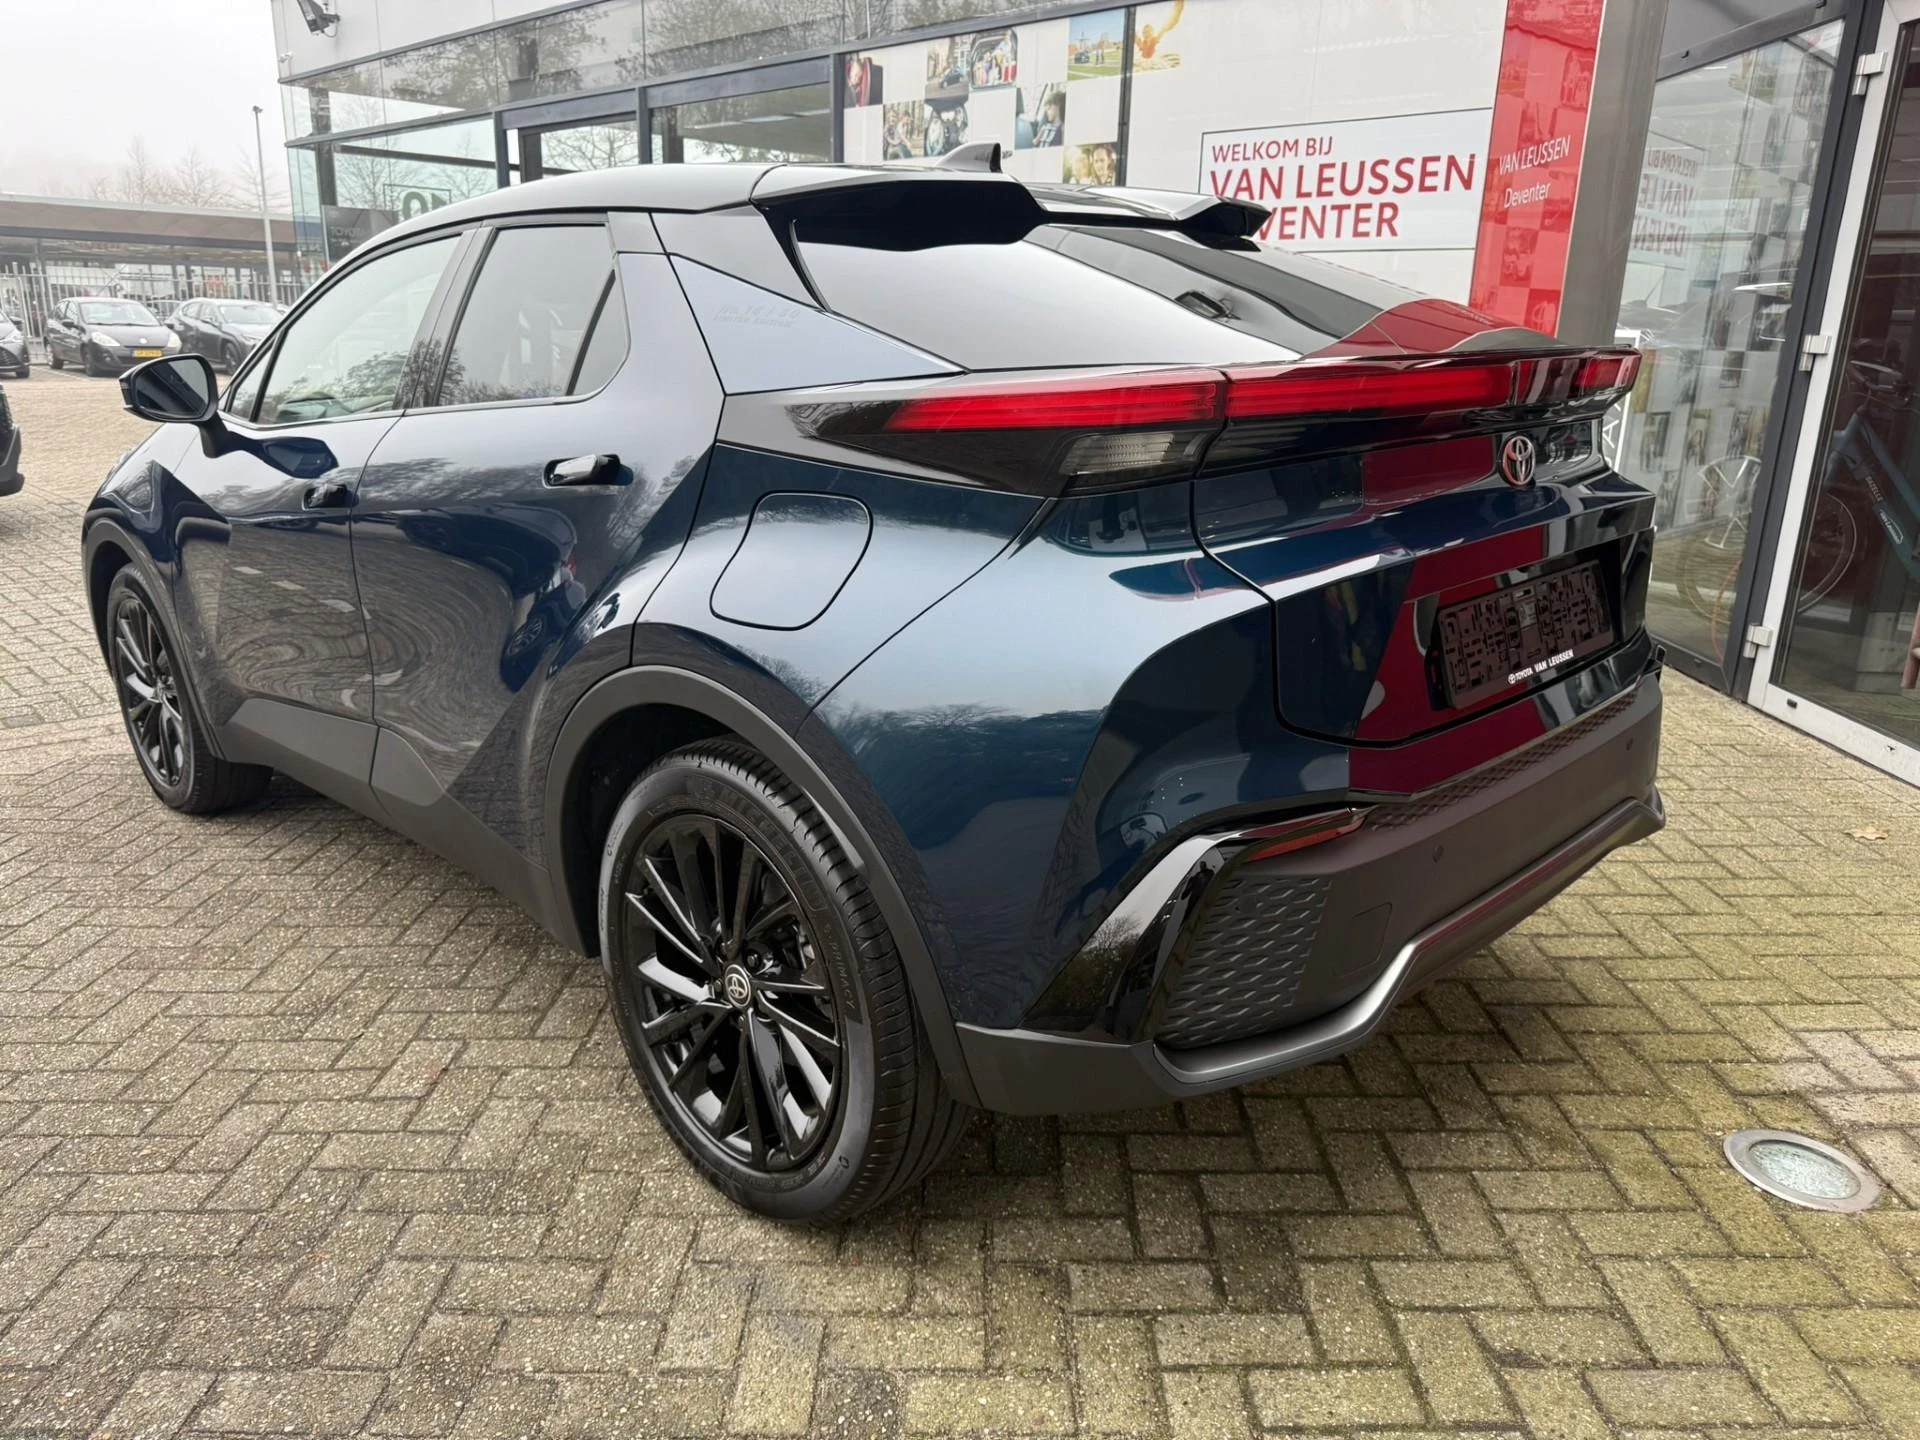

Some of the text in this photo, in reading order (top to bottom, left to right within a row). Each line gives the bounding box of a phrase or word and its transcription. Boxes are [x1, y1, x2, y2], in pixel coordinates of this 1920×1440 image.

[1212, 136, 1333, 163] WELKOM BIJ
[1499, 134, 1571, 176] VAN LEUSSEN
[1210, 153, 1476, 201] VAN LEUSSEN
[1503, 181, 1551, 208] Deventer
[1258, 202, 1399, 241] VENTER
[1514, 648, 1574, 681] TOYOTA VAN LEUSSEN
